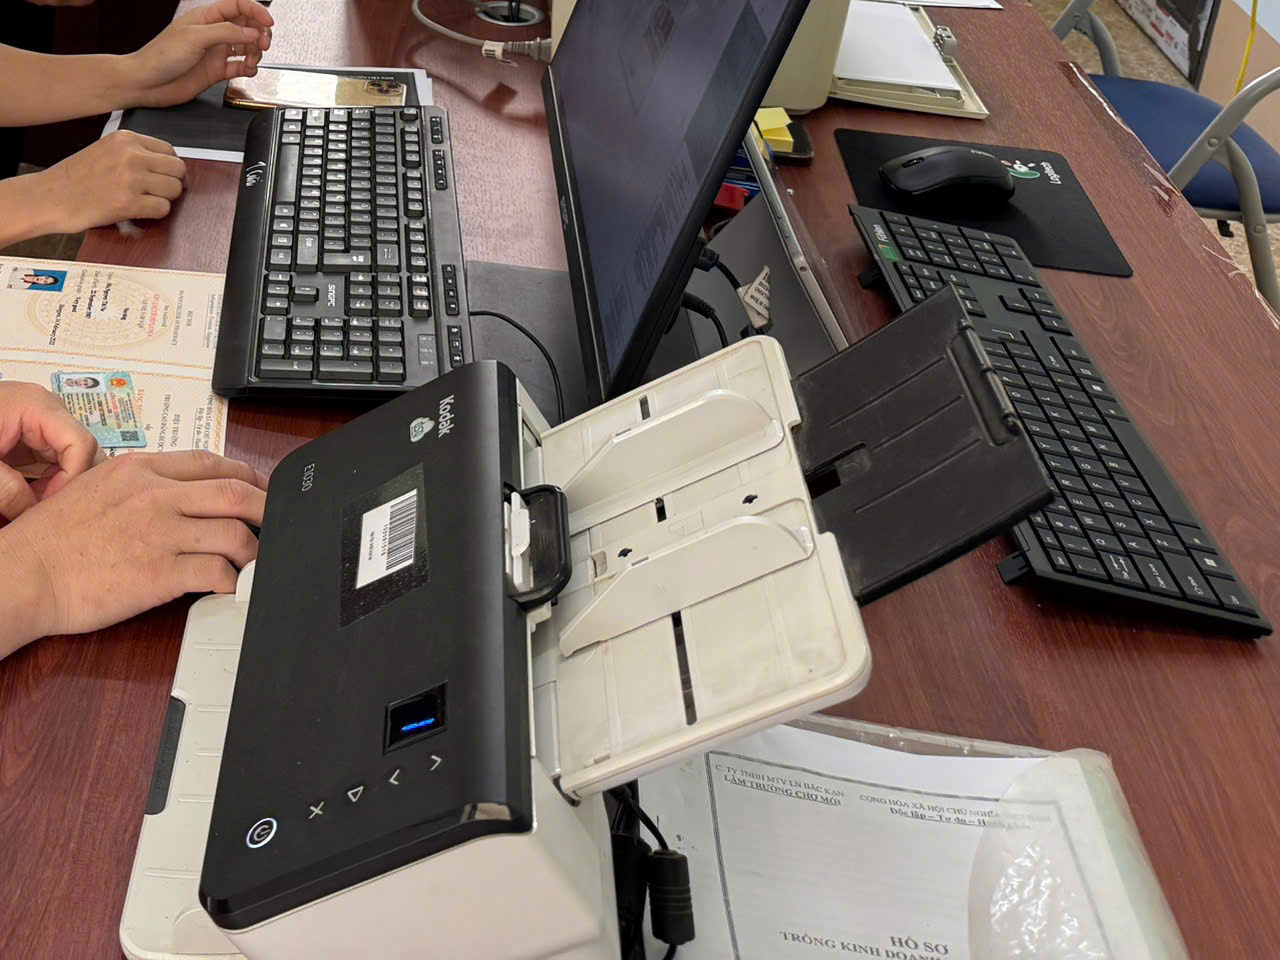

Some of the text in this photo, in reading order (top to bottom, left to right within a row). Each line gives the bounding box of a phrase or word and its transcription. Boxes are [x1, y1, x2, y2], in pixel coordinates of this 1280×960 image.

[438, 394, 455, 438] Kodak
[301, 463, 316, 491] E1030
[766, 775, 787, 785] MTV
[840, 941, 881, 957] KINH
